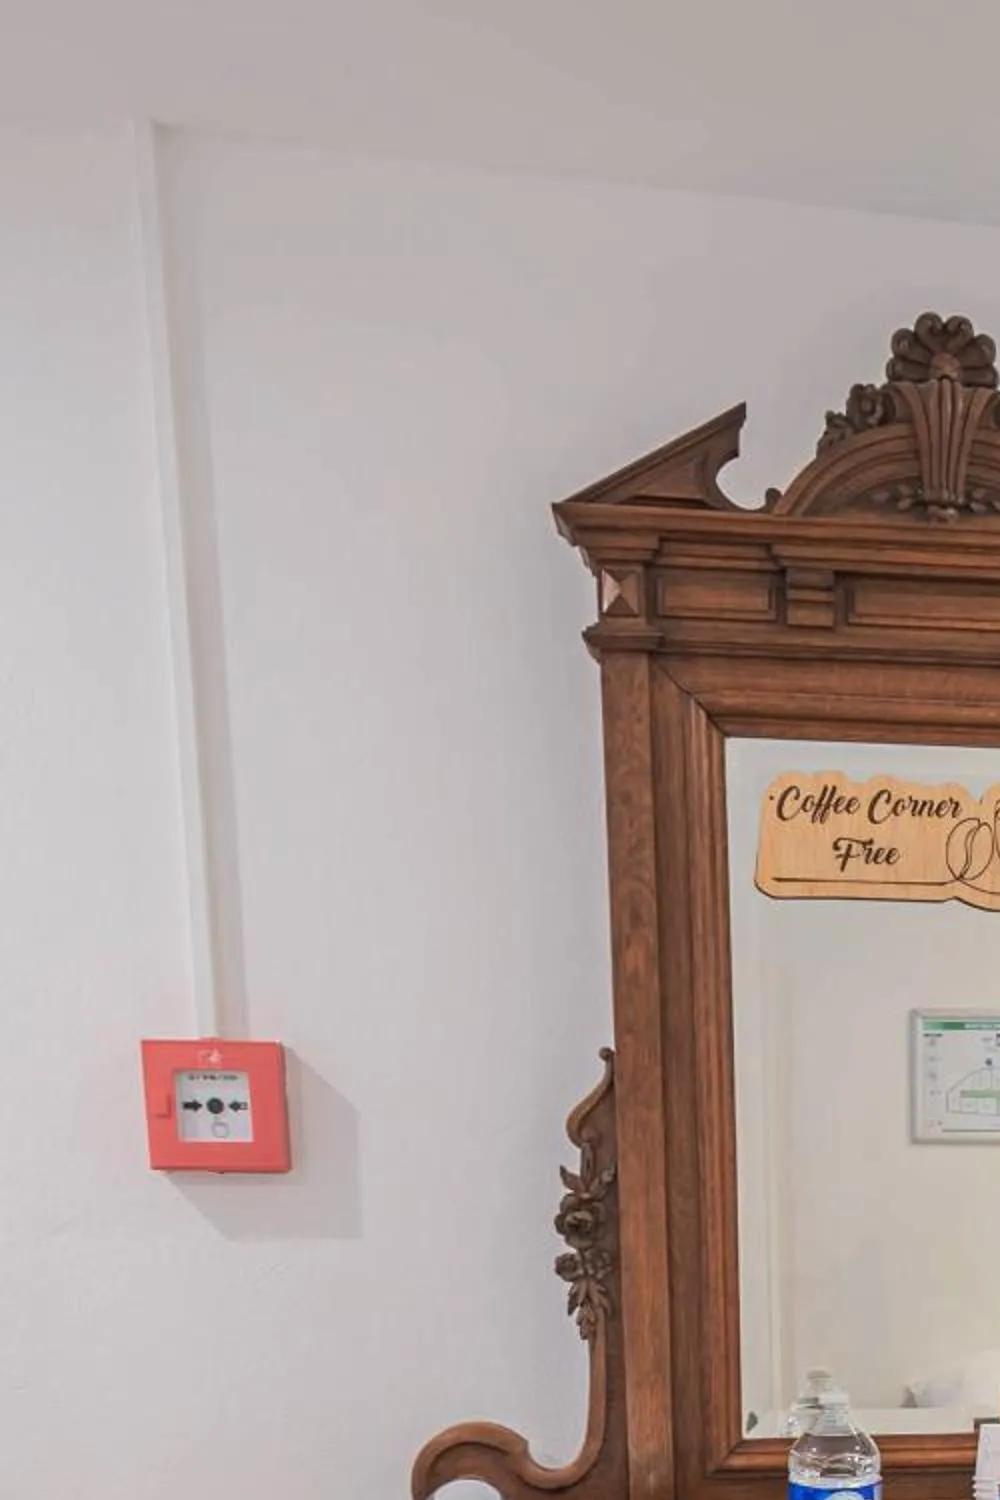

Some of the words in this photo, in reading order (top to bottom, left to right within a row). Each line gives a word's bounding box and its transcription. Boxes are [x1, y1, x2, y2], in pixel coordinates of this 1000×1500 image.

[776, 785, 860, 824] Coffee
[867, 788, 963, 824] Corner
[831, 836, 901, 873] Free
